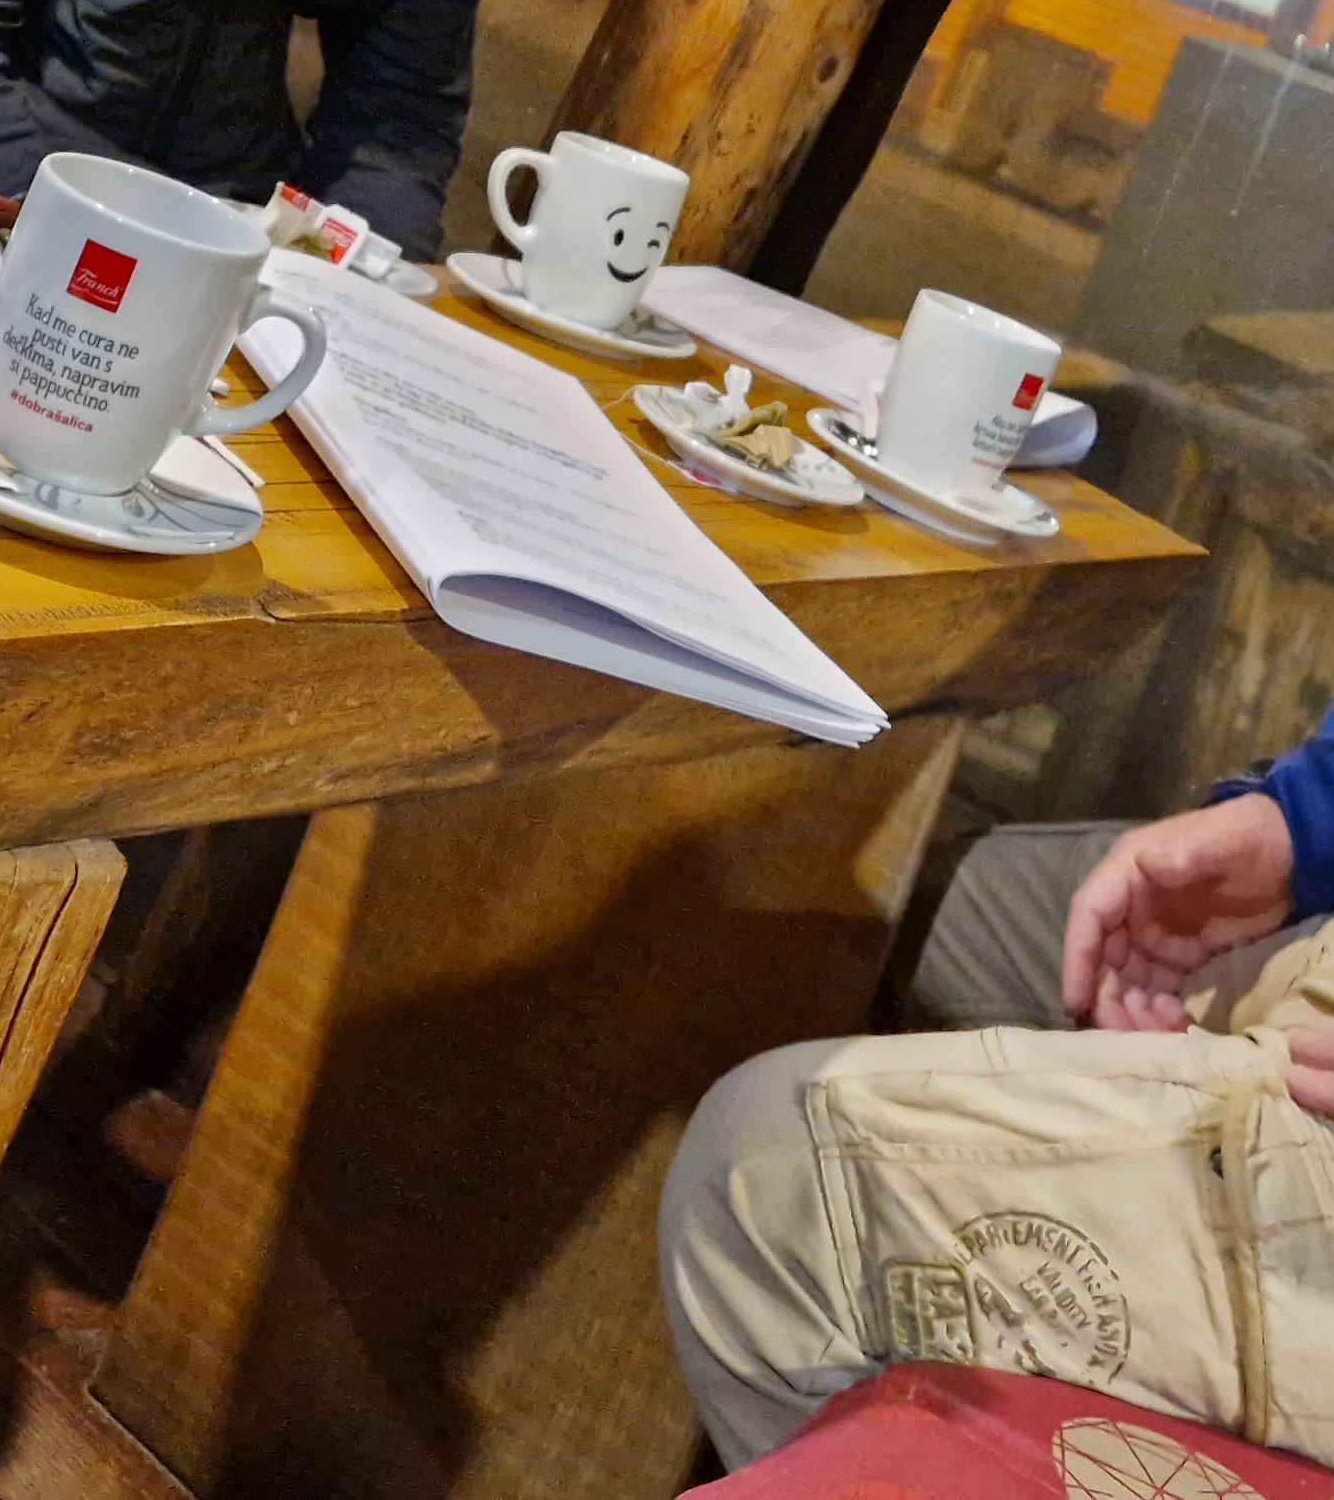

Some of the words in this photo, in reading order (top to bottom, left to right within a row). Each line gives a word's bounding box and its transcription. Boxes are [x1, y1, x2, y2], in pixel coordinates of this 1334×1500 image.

[26, 293, 54, 325] Kad
[52, 316, 77, 338] me
[78, 329, 115, 353] cura
[117, 343, 140, 360] ne
[29, 328, 69, 357] pusti
[71, 347, 101, 370] van
[103, 359, 114, 374] s
[2, 325, 56, 378] dečkima,
[60, 364, 140, 399] napravim
[9, 359, 22, 375] si
[18, 366, 110, 413] pappuccino.
[10, 389, 94, 433] #dobrašalica
